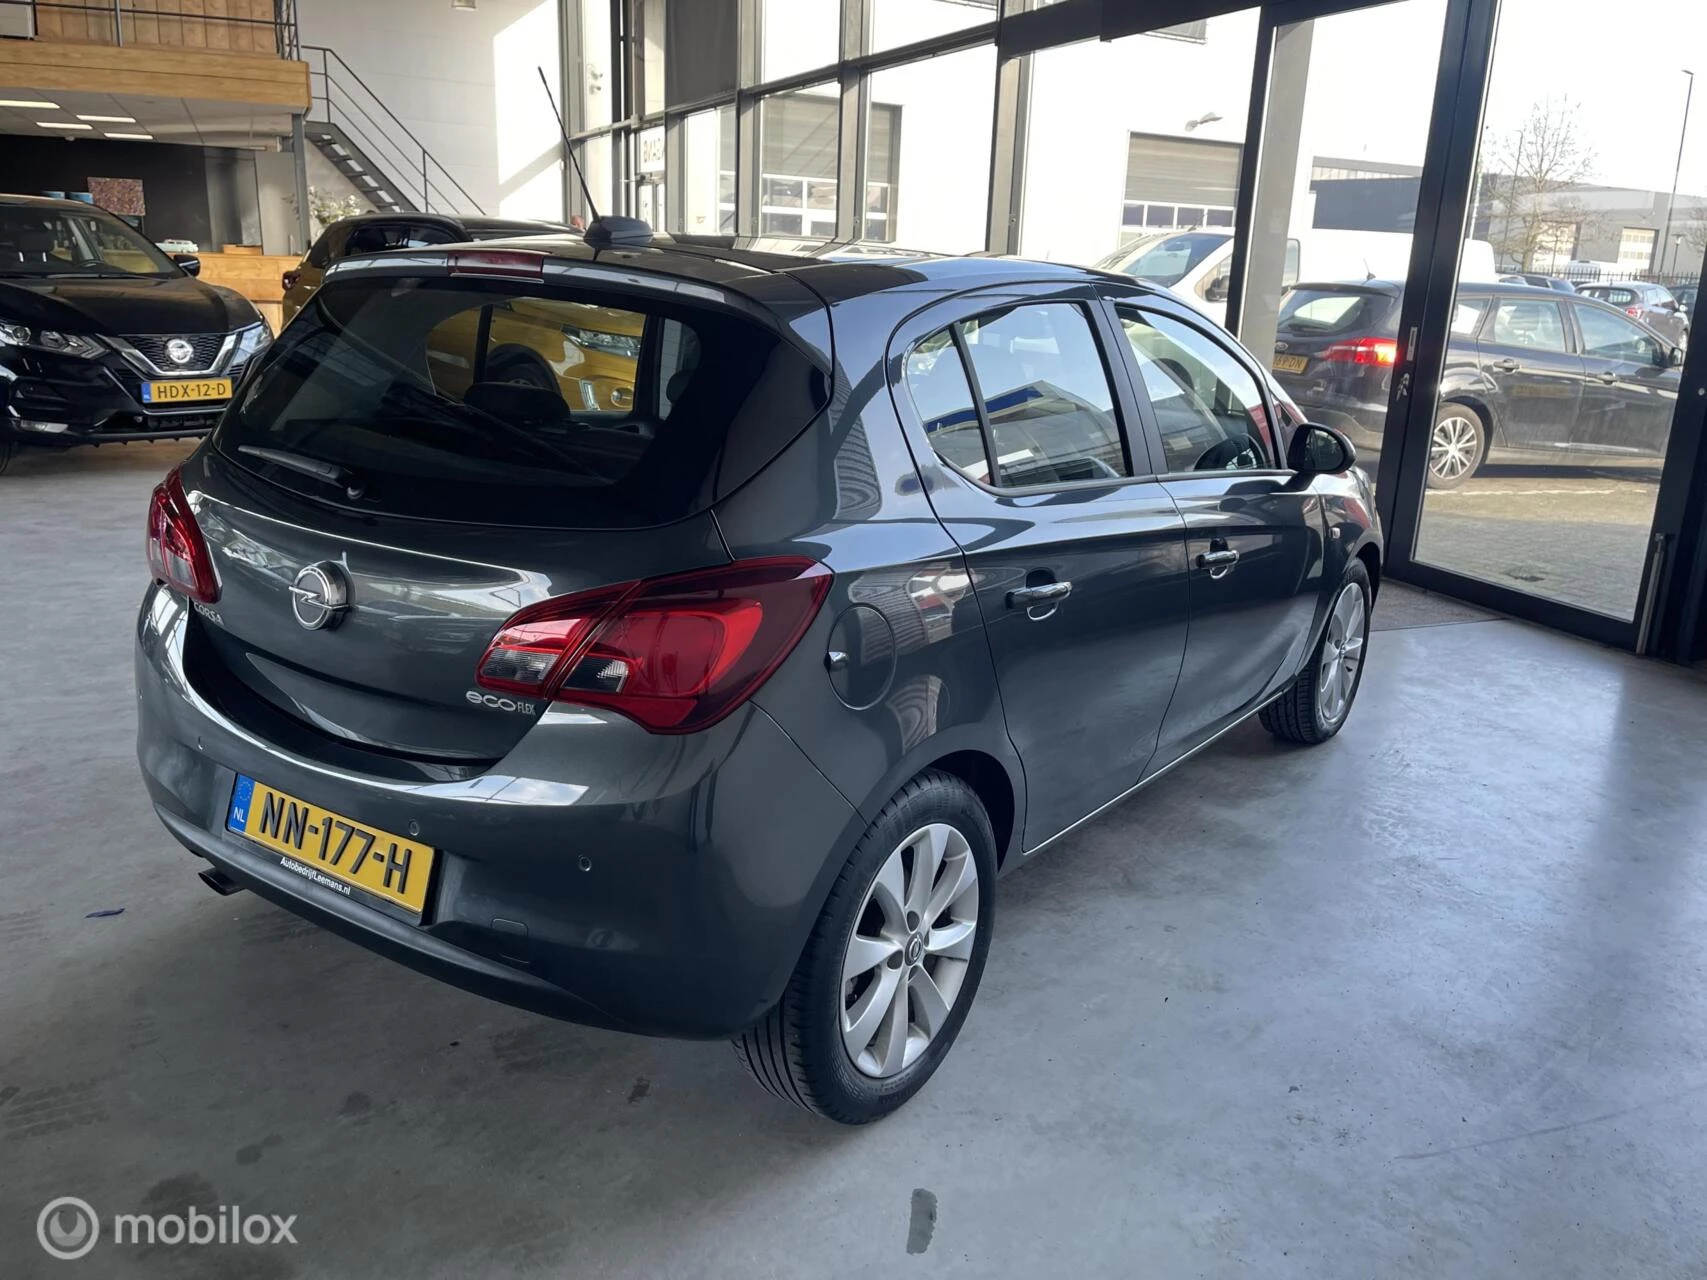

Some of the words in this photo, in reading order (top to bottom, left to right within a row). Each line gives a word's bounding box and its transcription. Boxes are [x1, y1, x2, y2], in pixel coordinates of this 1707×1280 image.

[157, 383, 226, 399] HDX-12-D
[193, 601, 225, 626] CORSA
[233, 806, 245, 823] NL
[259, 791, 412, 895] NN-177-H
[280, 857, 351, 895] AutobedrijfLeemans.nl
